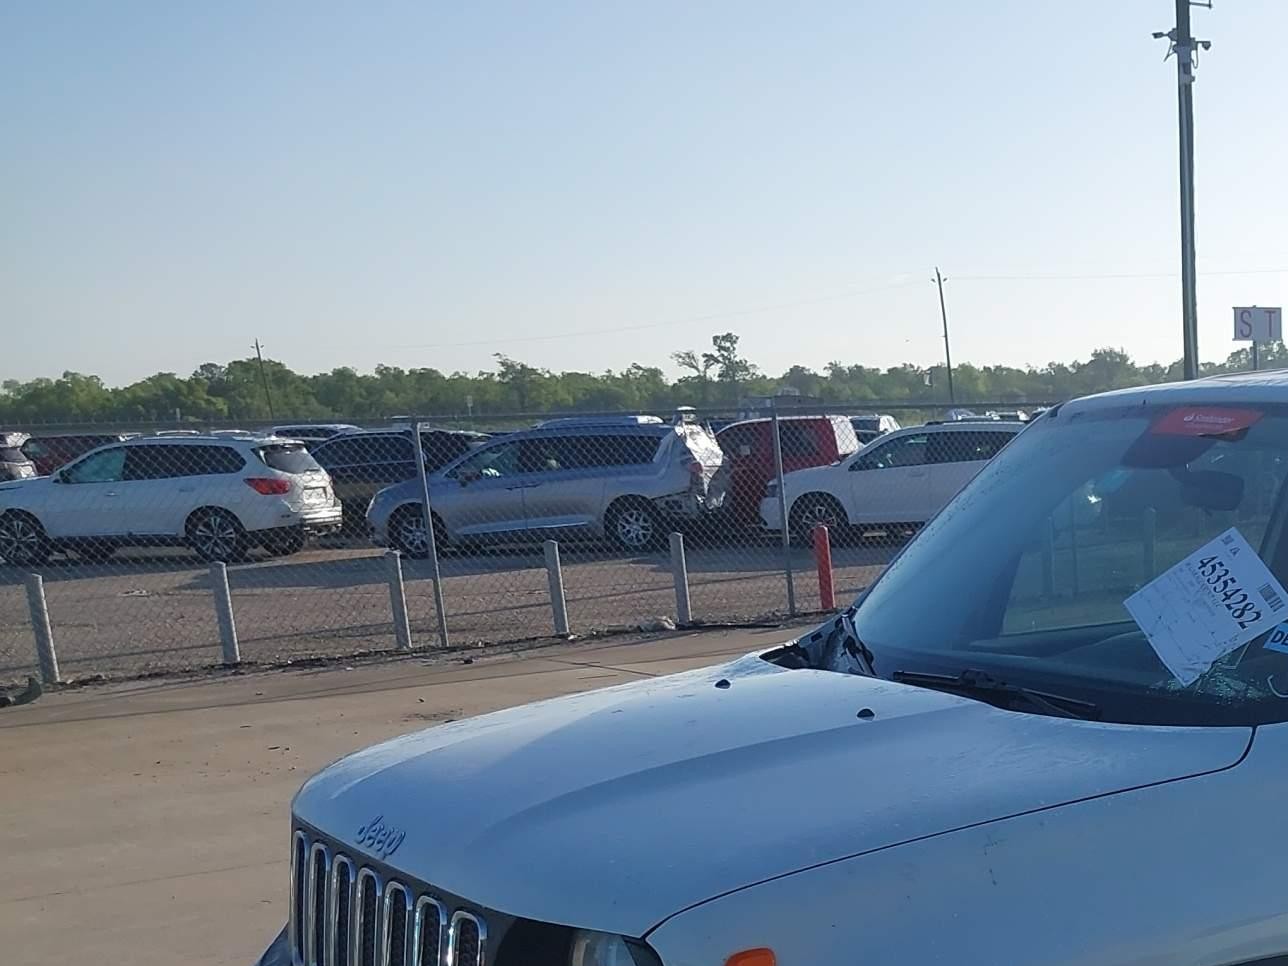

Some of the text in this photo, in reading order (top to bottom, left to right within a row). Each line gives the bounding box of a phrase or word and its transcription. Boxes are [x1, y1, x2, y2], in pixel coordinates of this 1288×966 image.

[1238, 310, 1278, 339] S T
[1196, 554, 1262, 631] 45354282
